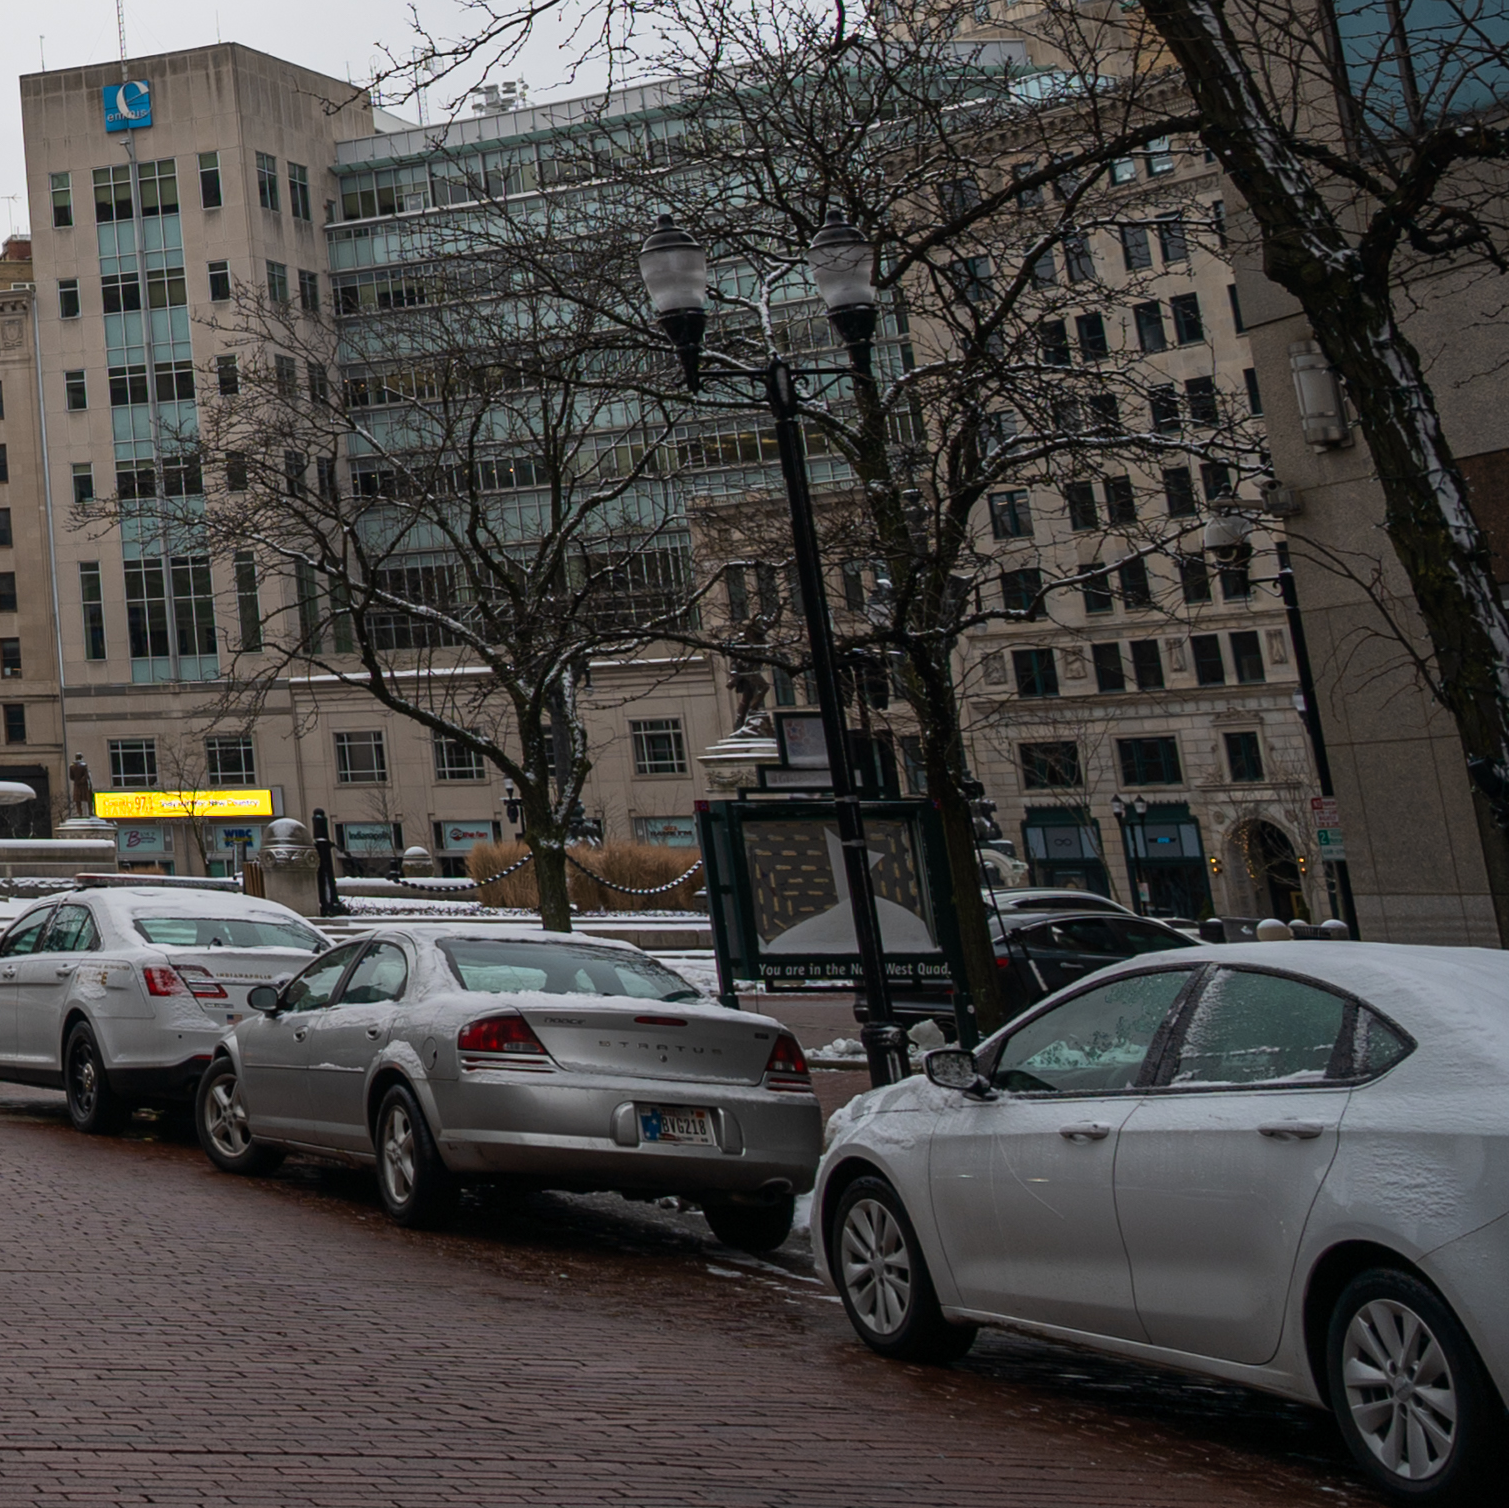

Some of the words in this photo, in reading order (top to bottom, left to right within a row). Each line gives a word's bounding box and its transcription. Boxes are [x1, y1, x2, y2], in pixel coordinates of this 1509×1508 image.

[758, 963, 781, 976] You
[785, 965, 805, 976] are
[809, 963, 821, 976] in
[826, 963, 846, 976] the
[885, 962, 913, 975] West
[917, 961, 952, 976] Quad.
[598, 1039, 723, 1056] STRATUS
[662, 1117, 707, 1135] BVG218
